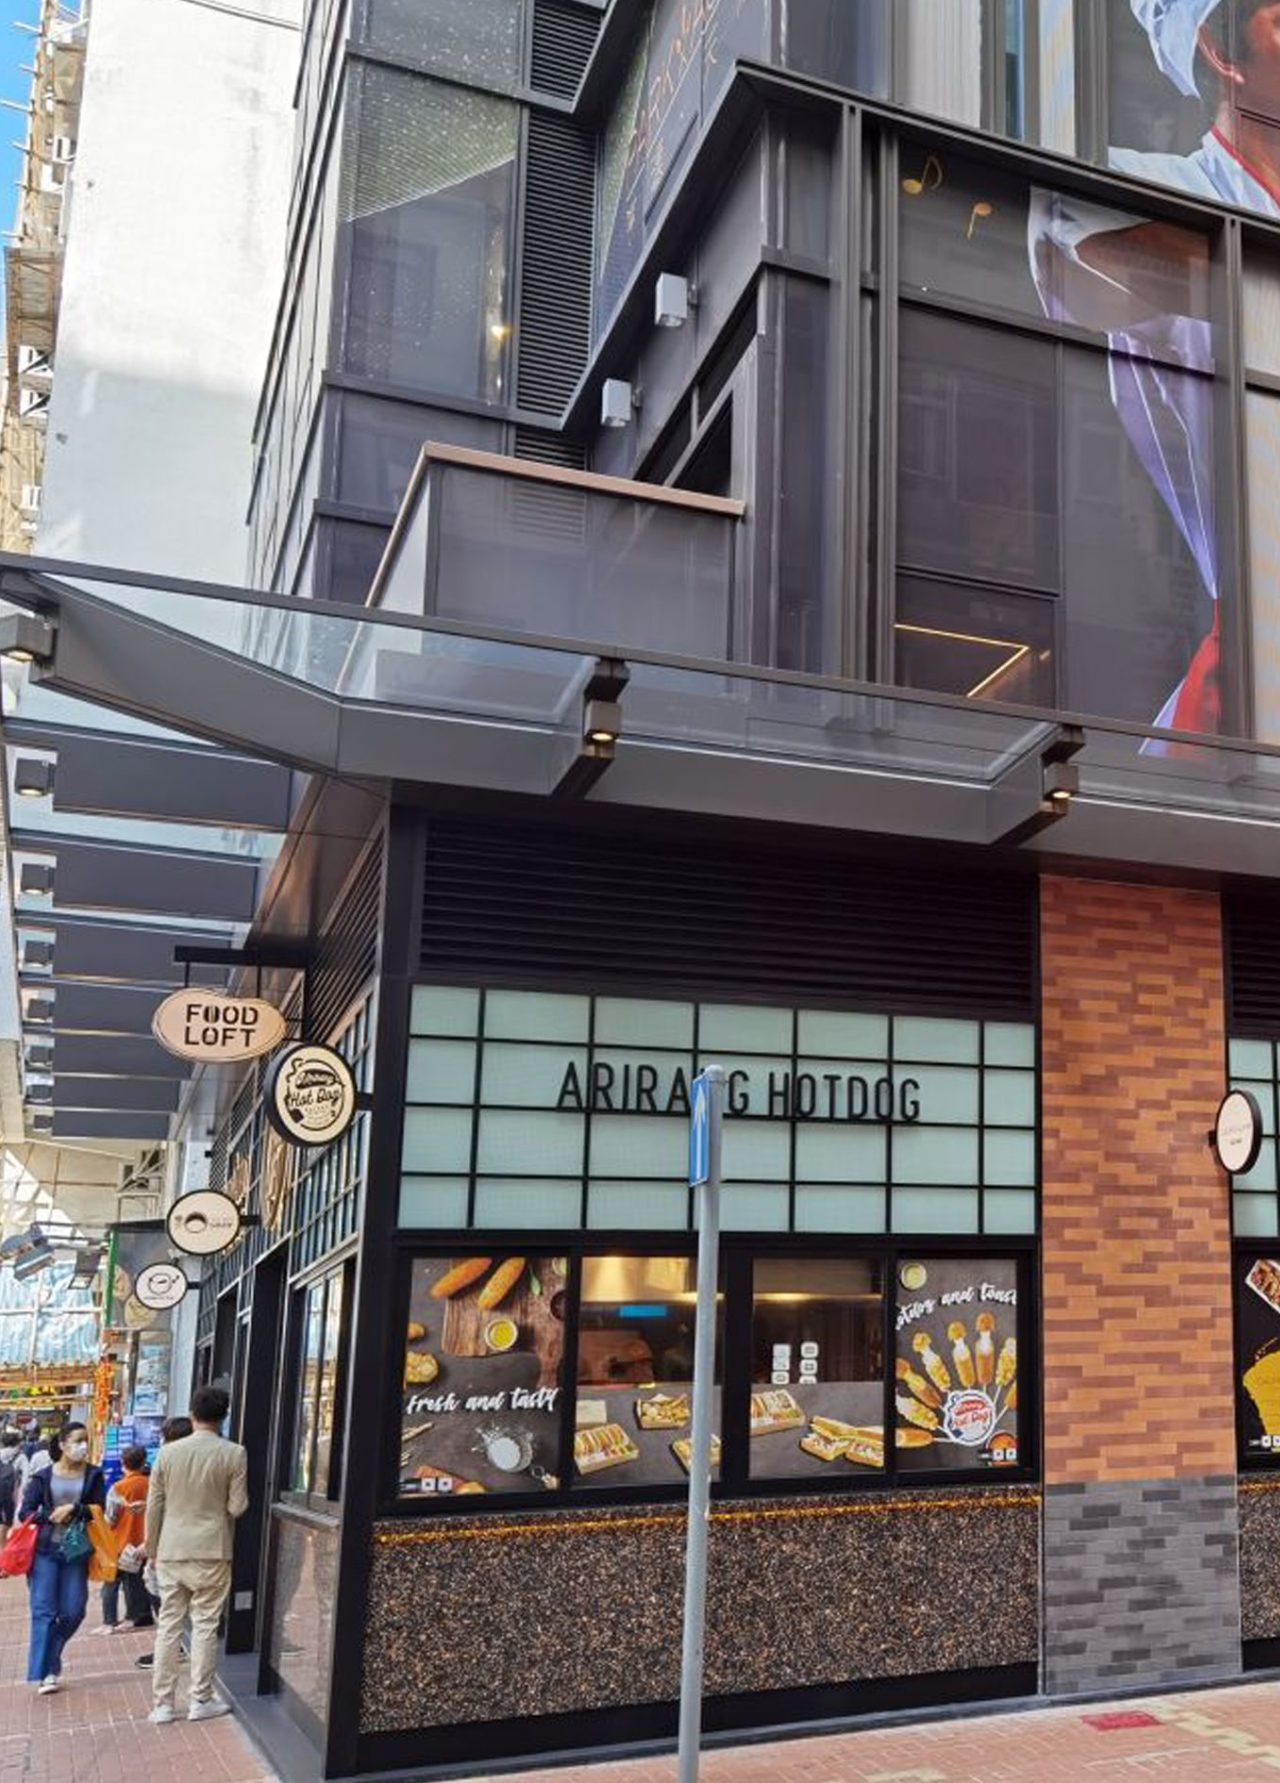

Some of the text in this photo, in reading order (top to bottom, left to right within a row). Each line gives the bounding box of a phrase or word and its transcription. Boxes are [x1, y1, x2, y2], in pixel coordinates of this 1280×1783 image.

[185, 1004, 259, 1026] FOOD
[184, 1026, 257, 1047] LOFT
[556, 1061, 921, 1123] ARIRAG HOTDOG
[941, 1286, 975, 1305] and
[465, 1390, 505, 1411] and
[511, 1386, 560, 1412] tasty
